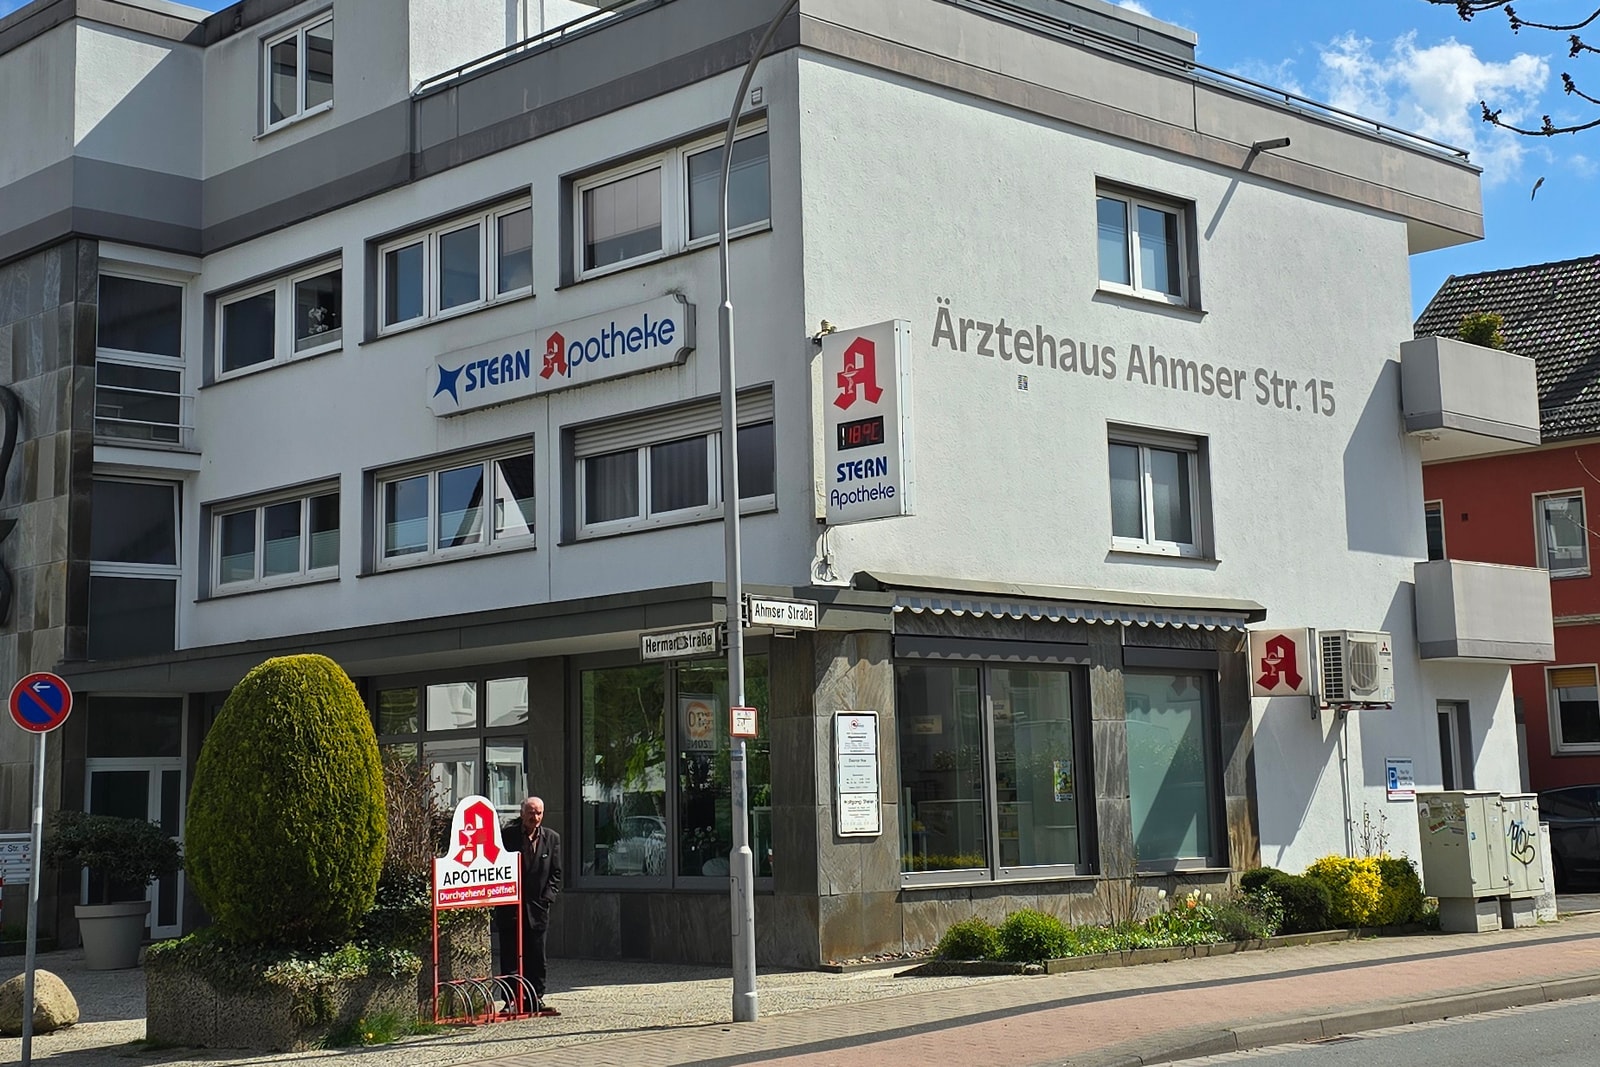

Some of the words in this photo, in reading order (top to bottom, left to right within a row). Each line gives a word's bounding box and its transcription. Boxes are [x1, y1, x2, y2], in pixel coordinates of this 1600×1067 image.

[465, 349, 530, 392] STERN
[539, 313, 675, 380] Apotheke
[931, 296, 1116, 381] Ärztehaus
[1126, 343, 1248, 401] Ahmser
[836, 456, 888, 483] STERN
[830, 482, 896, 510] Apotheke
[754, 603, 785, 618] Ahmser
[787, 606, 813, 621] Straße
[443, 866, 512, 887] APOTHEKE
[439, 888, 486, 901] Durchgehend
[487, 885, 516, 897] geöffnet
